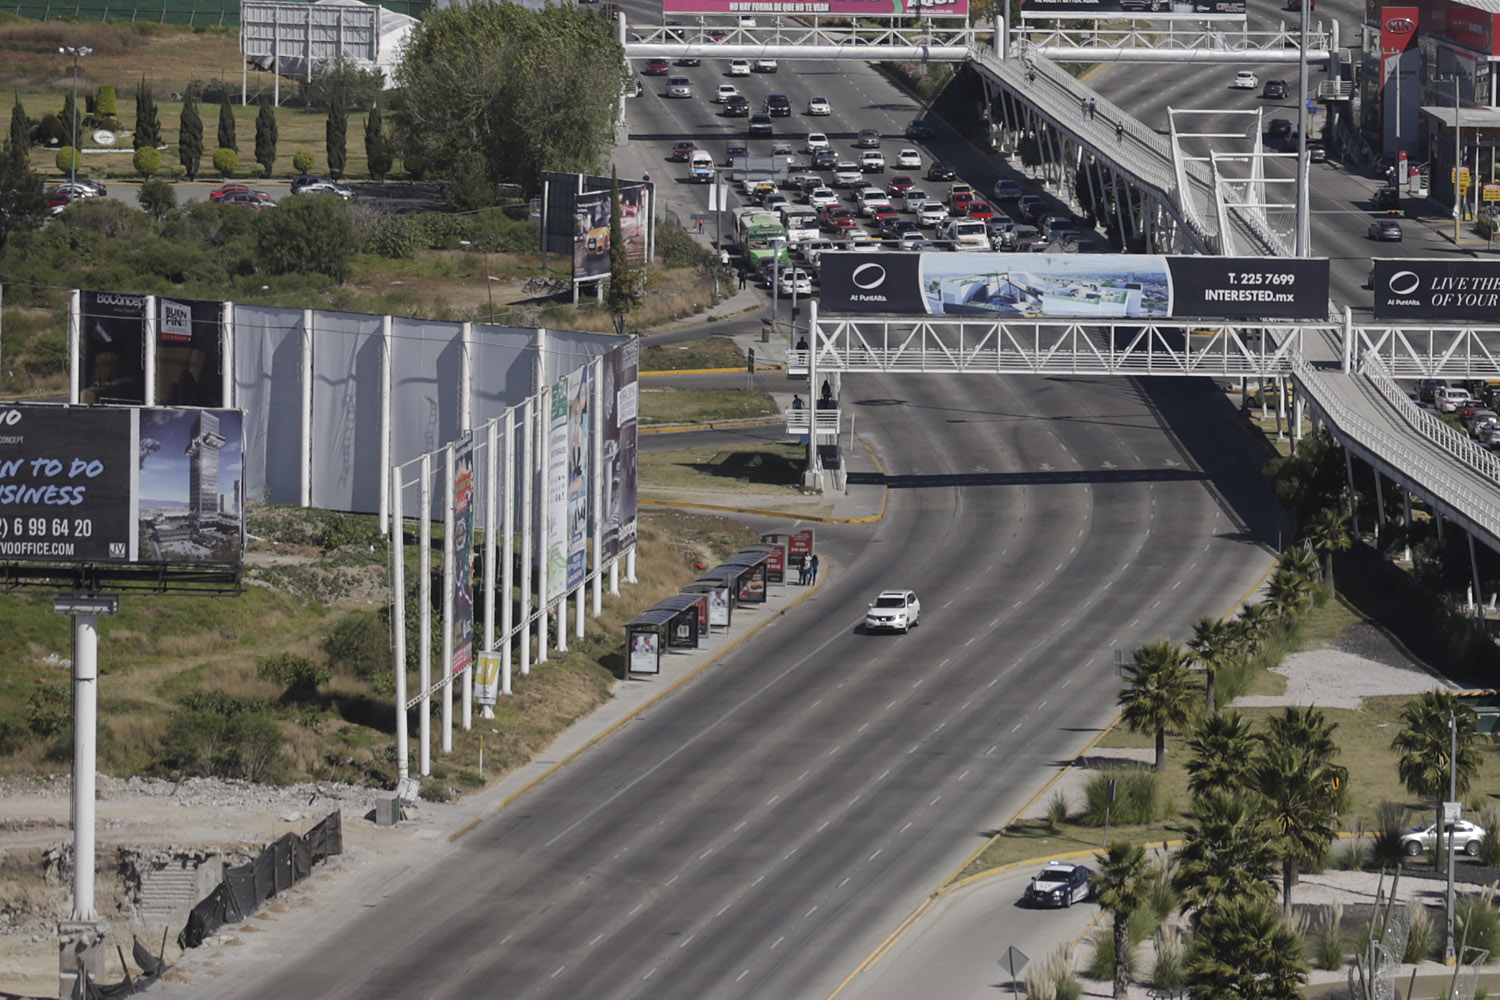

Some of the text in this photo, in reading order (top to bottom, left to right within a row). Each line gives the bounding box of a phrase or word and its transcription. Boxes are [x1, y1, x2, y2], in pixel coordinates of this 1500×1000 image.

[729, 2, 830, 12] NO HAY FORMA DE QUE NO TE VEAN
[1228, 274, 1295, 285] T. 225 7699
[1430, 276, 1467, 291] LIVE
[1204, 289, 1295, 303] INTERESTED.mx
[1430, 293, 1454, 307] OF
[1455, 293, 1498, 308] YOUR
[166, 306, 187, 318] BUEN
[31, 458, 104, 478] TO DO
[14, 518, 92, 537] 6 99 64 20
